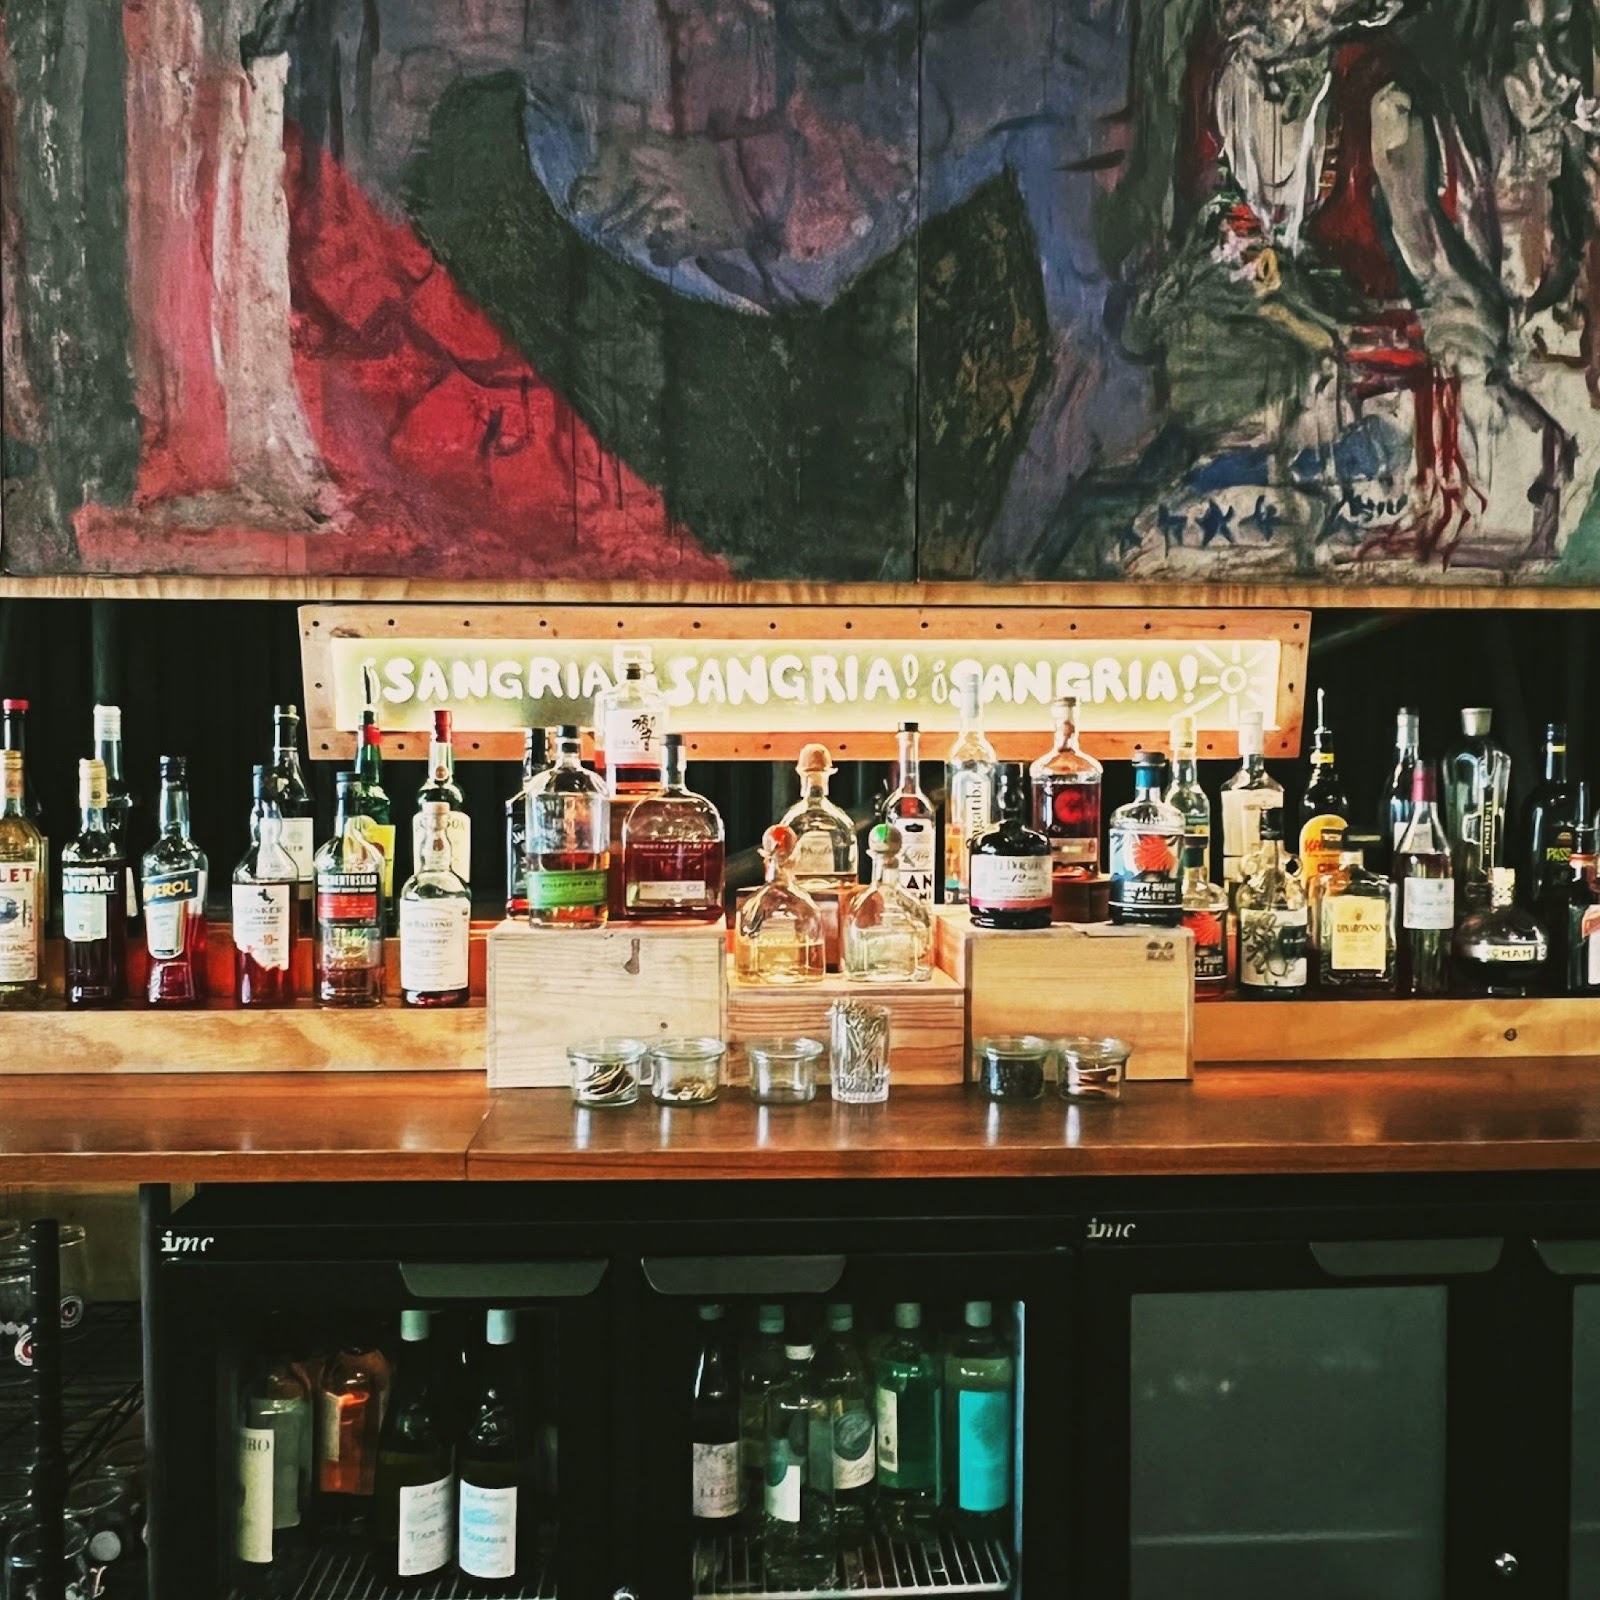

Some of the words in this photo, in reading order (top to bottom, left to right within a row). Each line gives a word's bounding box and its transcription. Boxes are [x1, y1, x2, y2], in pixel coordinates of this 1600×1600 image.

[63, 874, 115, 893] AMPARI
[1086, 1217, 1136, 1238] imc
[161, 1230, 214, 1251] imc
